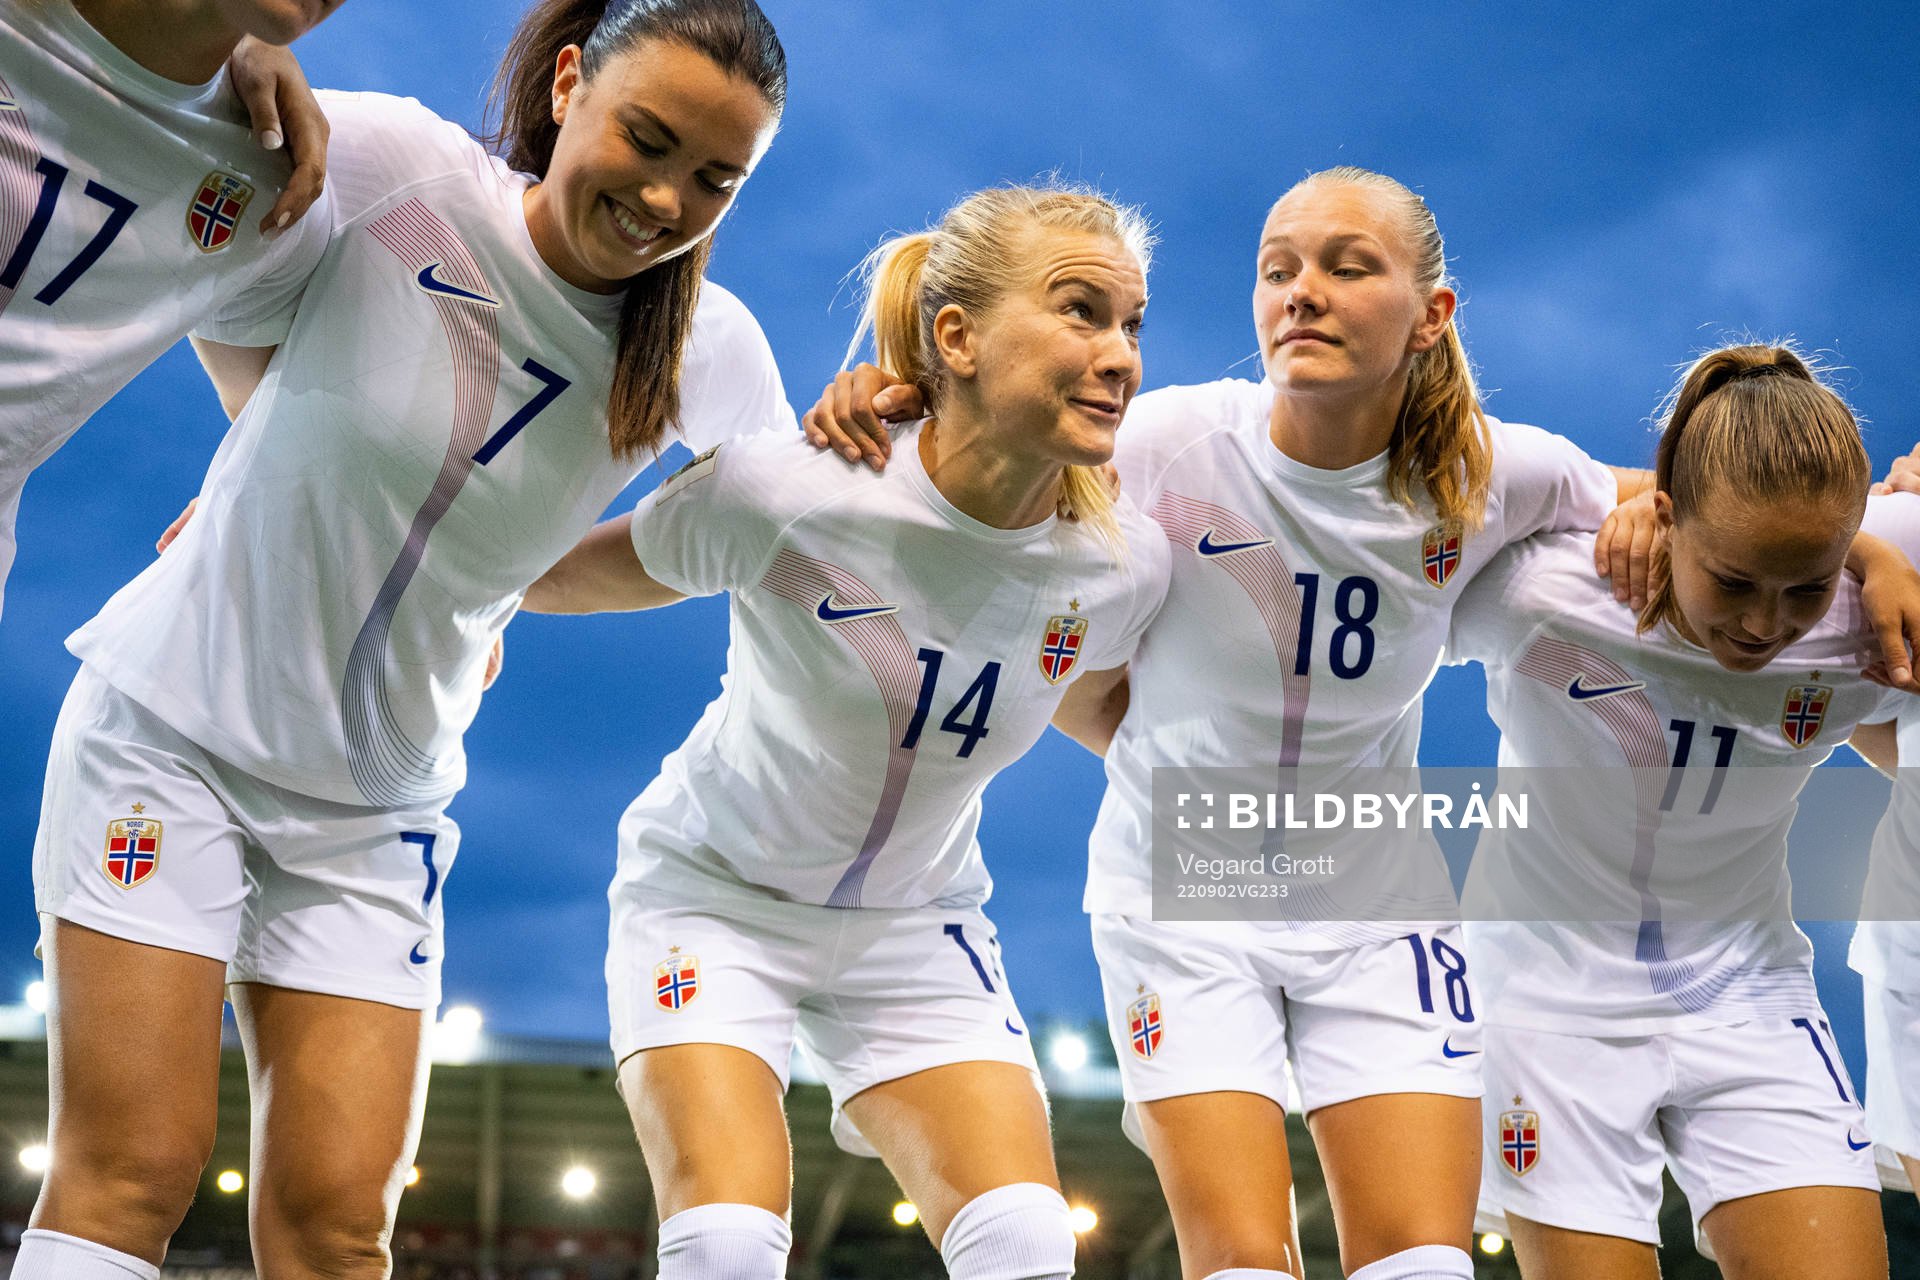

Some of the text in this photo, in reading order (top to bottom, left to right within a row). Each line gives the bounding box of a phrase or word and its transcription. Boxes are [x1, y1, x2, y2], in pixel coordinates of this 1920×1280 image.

[0, 156, 138, 306] 17
[471, 357, 573, 466] 7
[1294, 572, 1380, 680] 18
[899, 647, 1002, 759] 14
[1658, 718, 1739, 815] 11
[399, 831, 438, 906] 7
[943, 923, 1000, 994] 1
[1406, 932, 1475, 1023] 18
